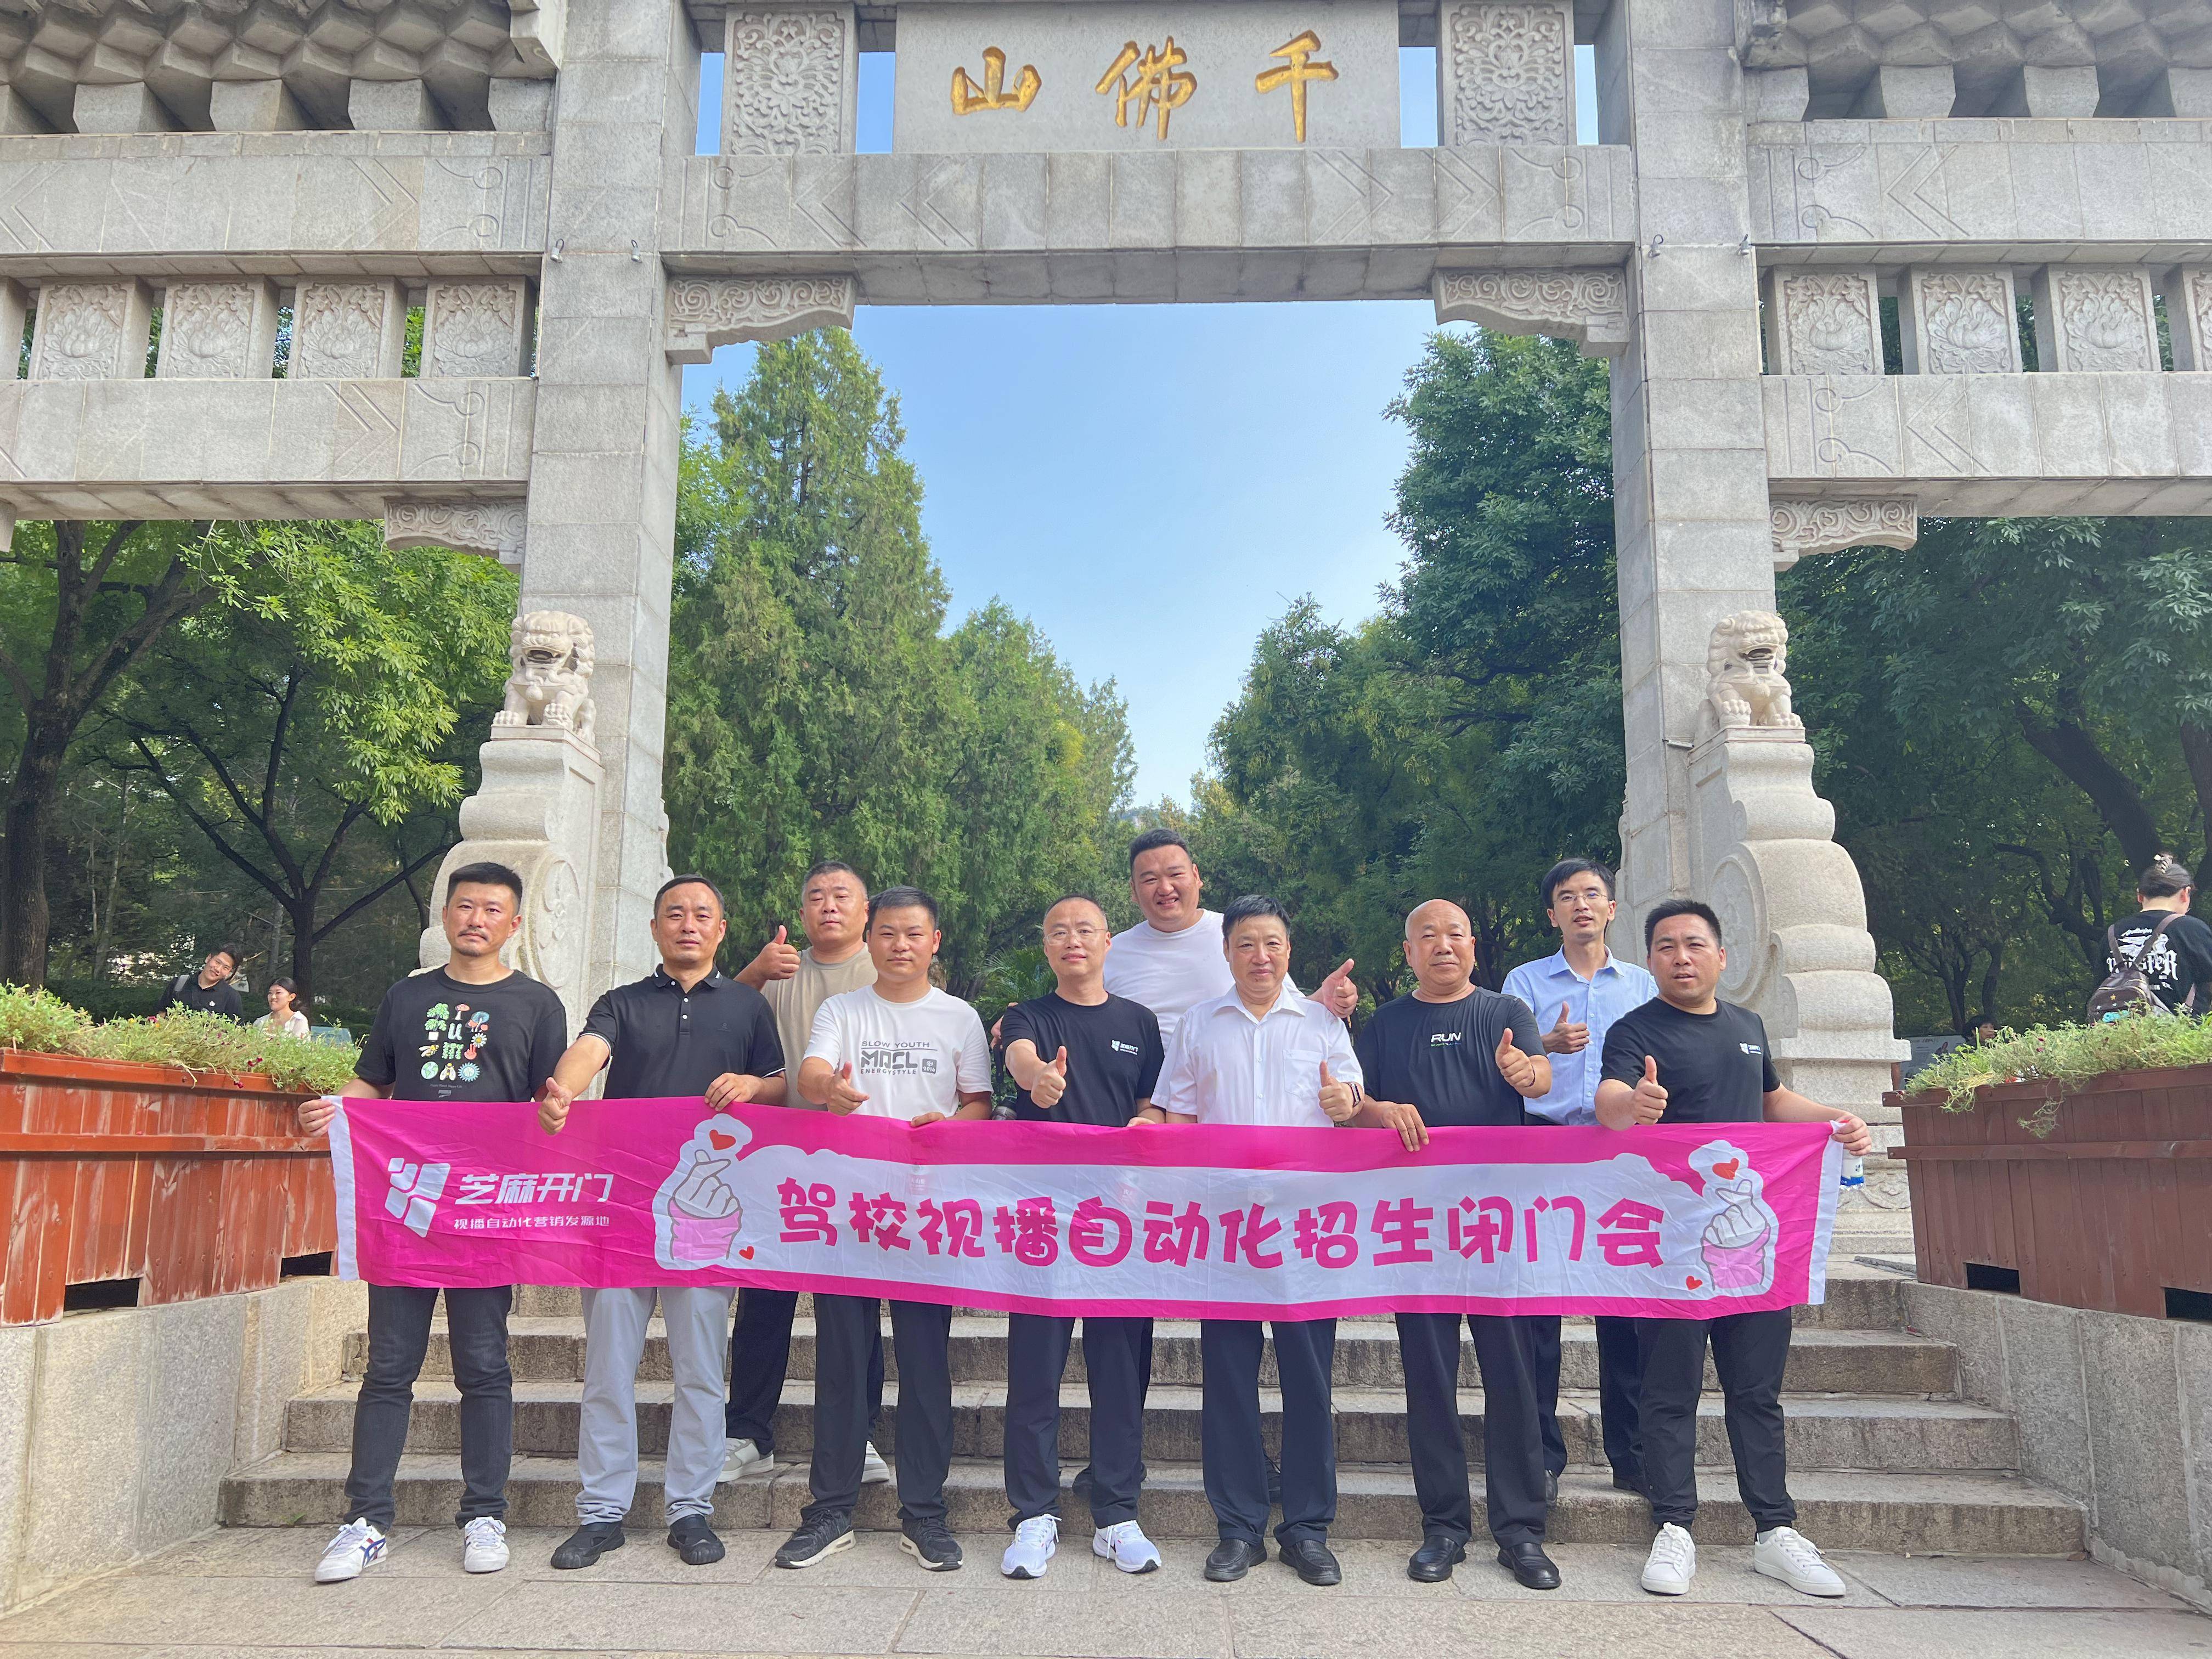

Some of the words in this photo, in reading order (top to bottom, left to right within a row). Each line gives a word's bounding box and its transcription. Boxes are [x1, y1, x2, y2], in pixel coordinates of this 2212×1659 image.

[1431, 1032, 1462, 1043] RUN
[455, 1173, 614, 1205] 芝麻开门
[454, 1215, 610, 1230] 视播自动化营销发源地
[776, 1176, 1665, 1268] 驾校视播自动化招生闭门会
